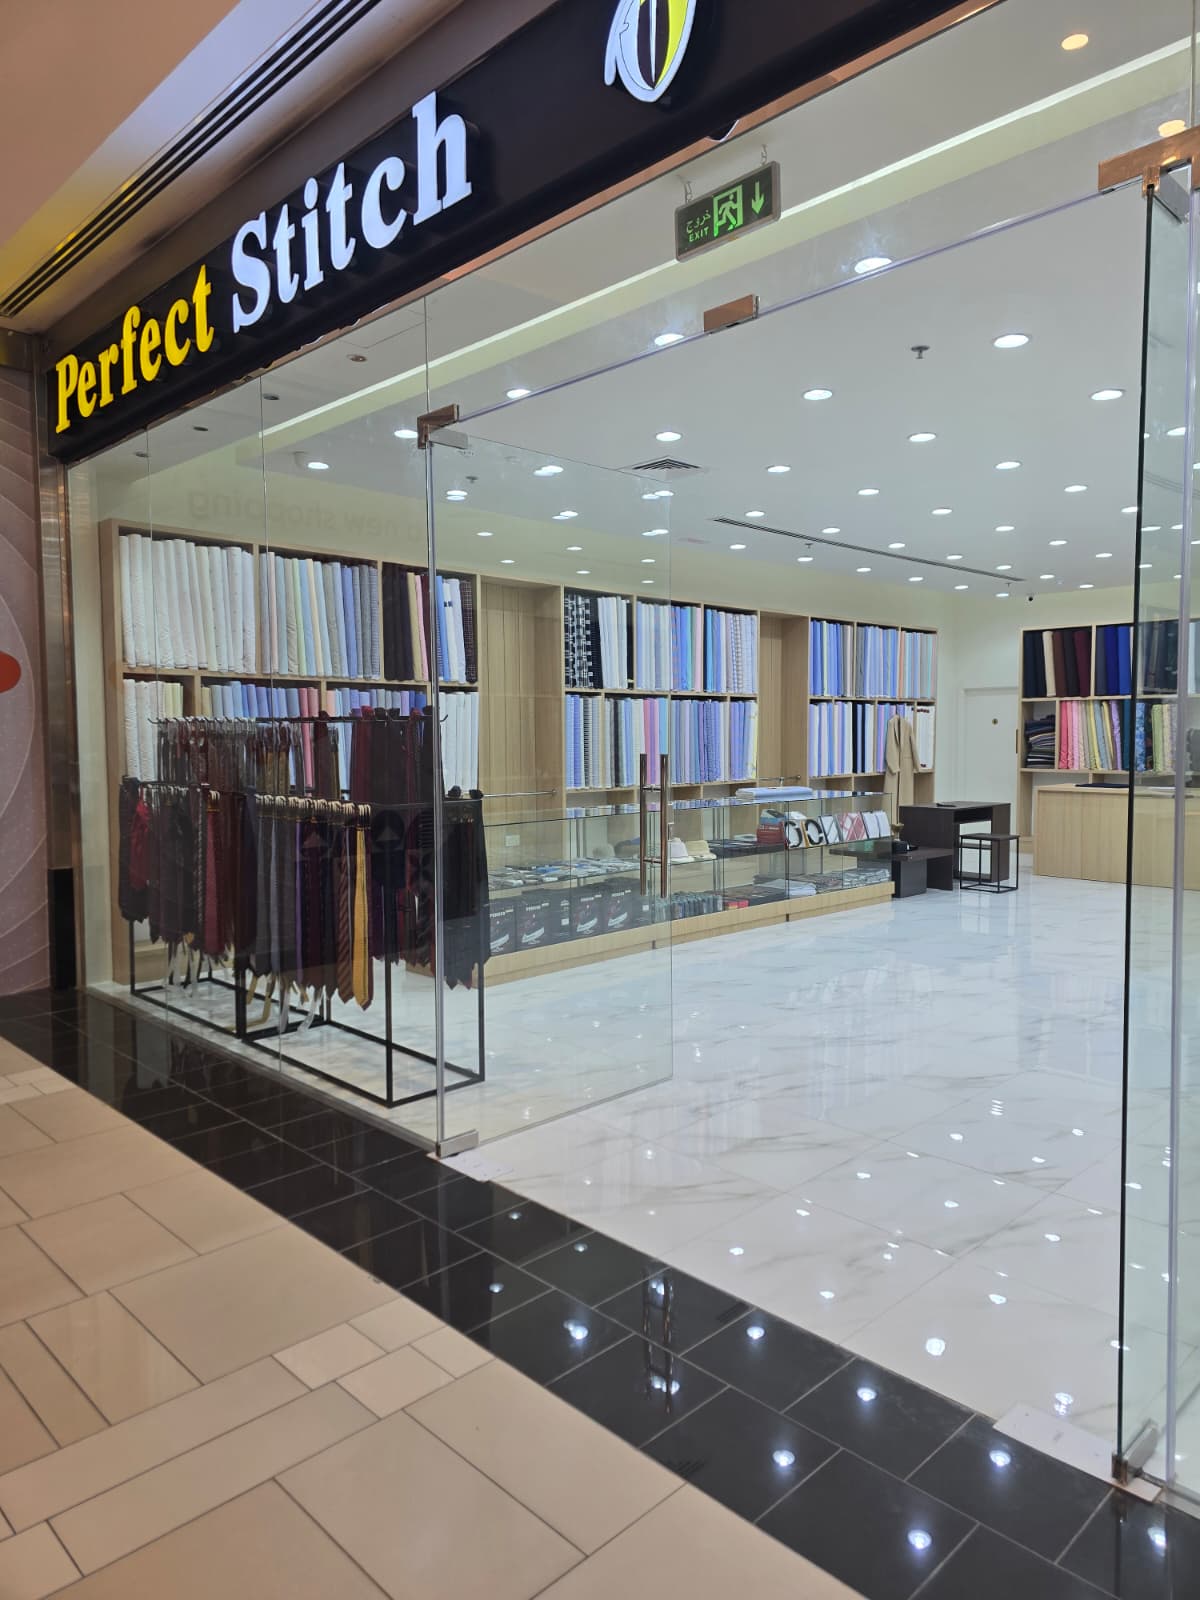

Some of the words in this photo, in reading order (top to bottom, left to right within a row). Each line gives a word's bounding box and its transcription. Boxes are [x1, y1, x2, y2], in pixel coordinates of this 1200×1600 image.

[686, 209, 711, 233] خروج
[689, 226, 709, 243] EXIT
[55, 264, 215, 434] Perfect
[231, 90, 473, 334] Stitch
